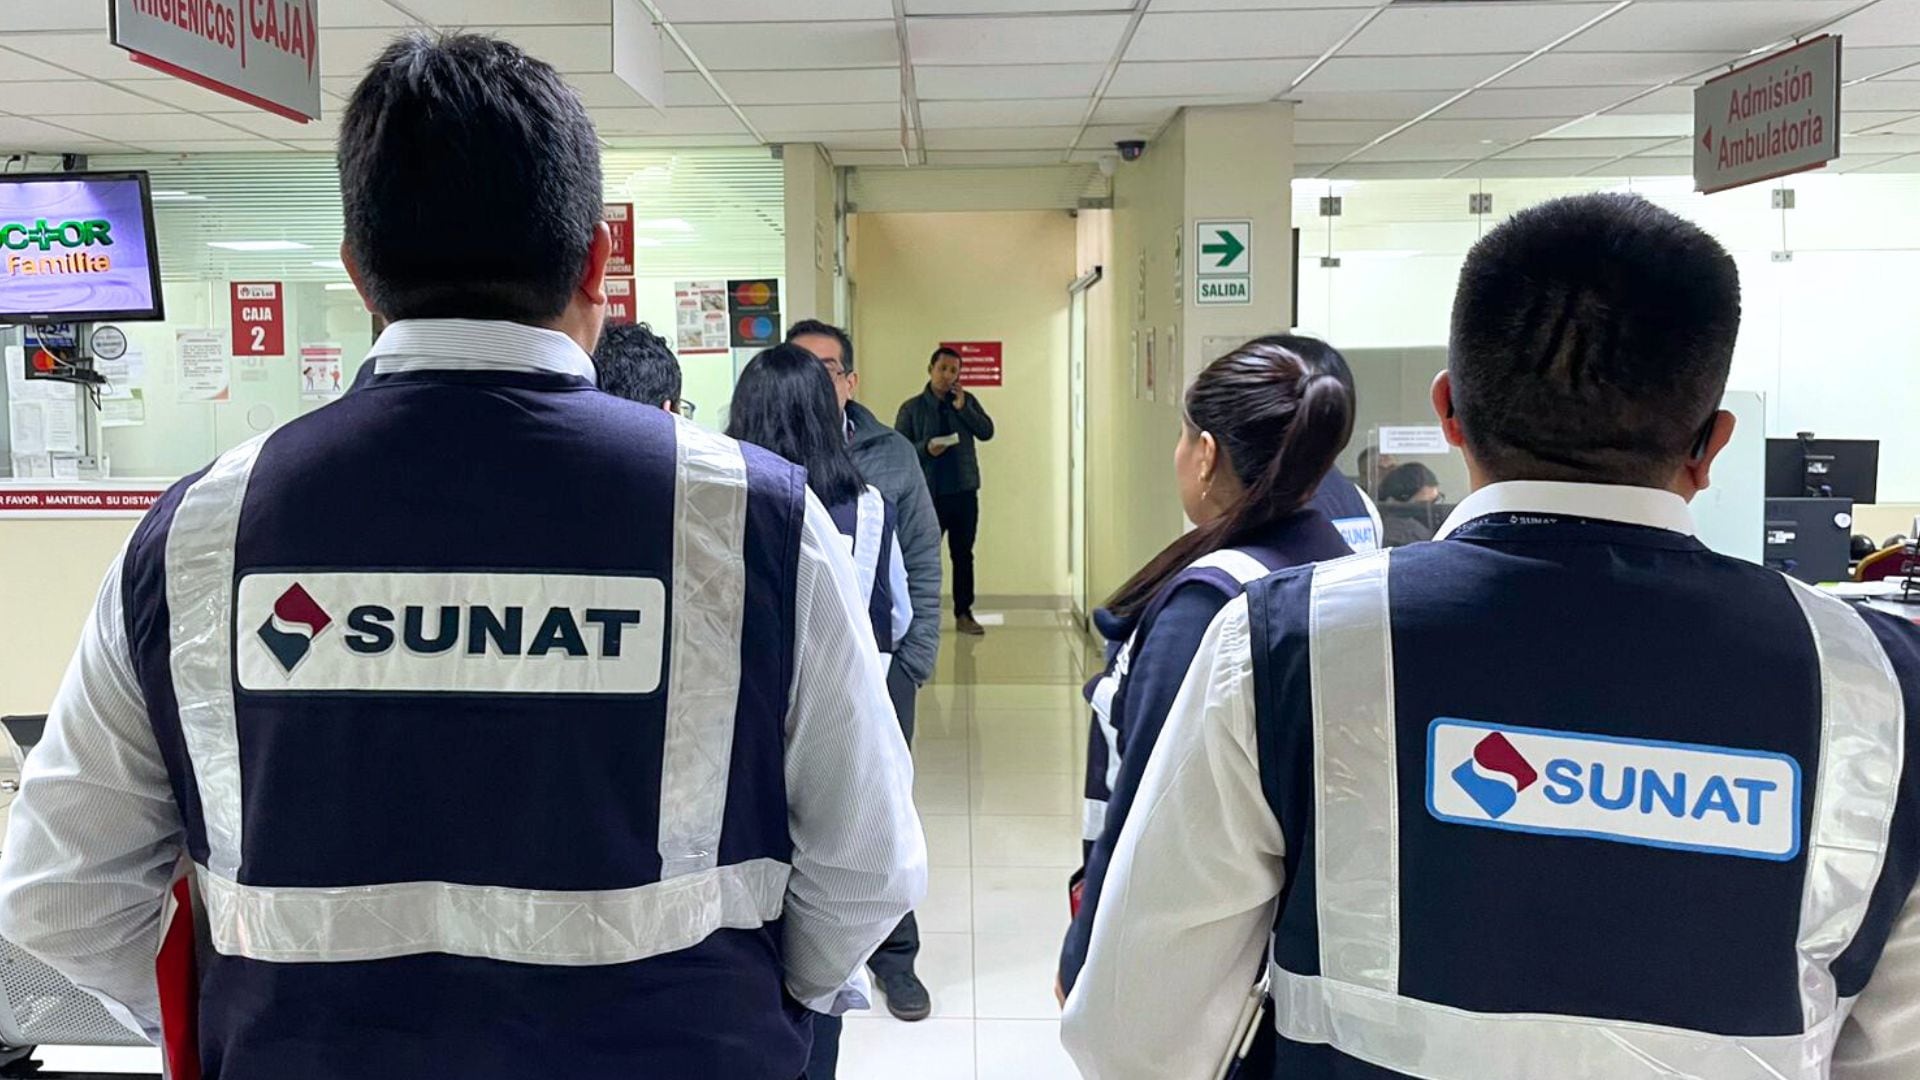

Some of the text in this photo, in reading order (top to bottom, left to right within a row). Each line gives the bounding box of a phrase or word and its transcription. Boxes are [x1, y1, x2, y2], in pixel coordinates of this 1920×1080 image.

[250, 0, 305, 59] CAJA
[1728, 65, 1813, 125] Admisión
[1717, 109, 1823, 171] Ambulatoria
[8, 253, 111, 276] Familia
[1201, 283, 1246, 297] SALIDA
[242, 307, 273, 321] CAJA
[606, 303, 626, 317] AJA
[251, 326, 265, 351] 2
[46, 495, 102, 505] MANTENGA
[106, 495, 120, 505] SU
[122, 495, 159, 505] DISTAN
[344, 605, 641, 658] SUNAT
[1543, 759, 1777, 826] SUNAT
